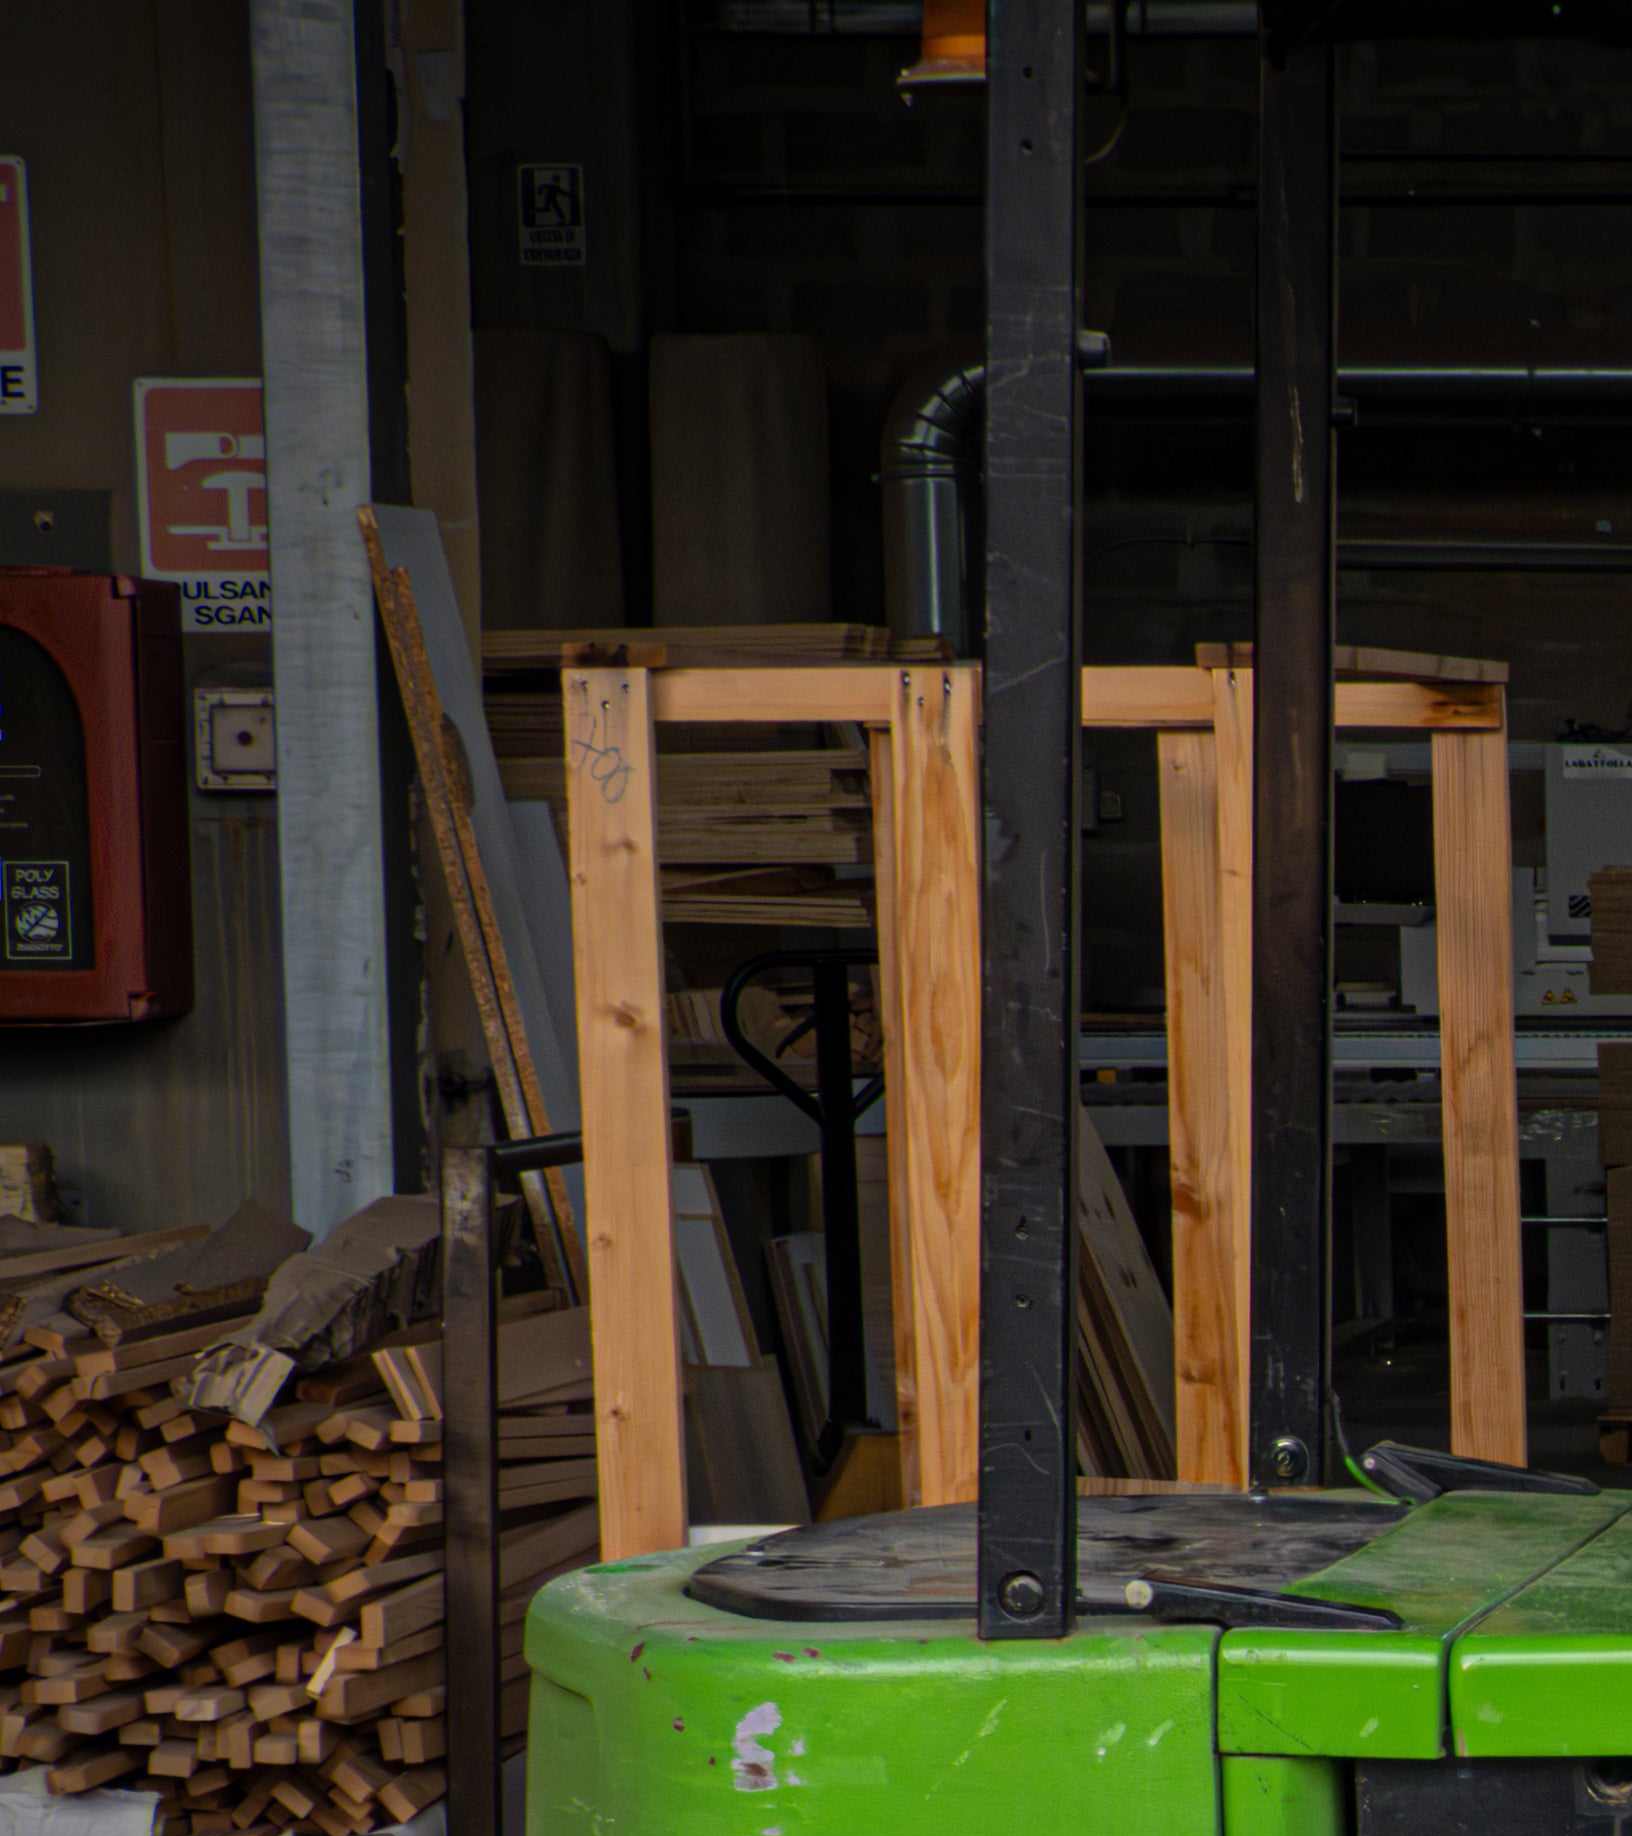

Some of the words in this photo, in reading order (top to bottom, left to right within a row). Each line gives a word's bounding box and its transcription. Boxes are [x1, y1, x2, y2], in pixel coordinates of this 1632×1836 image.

[0, 366, 24, 397] E
[182, 581, 272, 600] ULSAN
[194, 605, 272, 625] SGAN
[15, 867, 56, 883] POLY
[11, 885, 61, 900] GLASS
